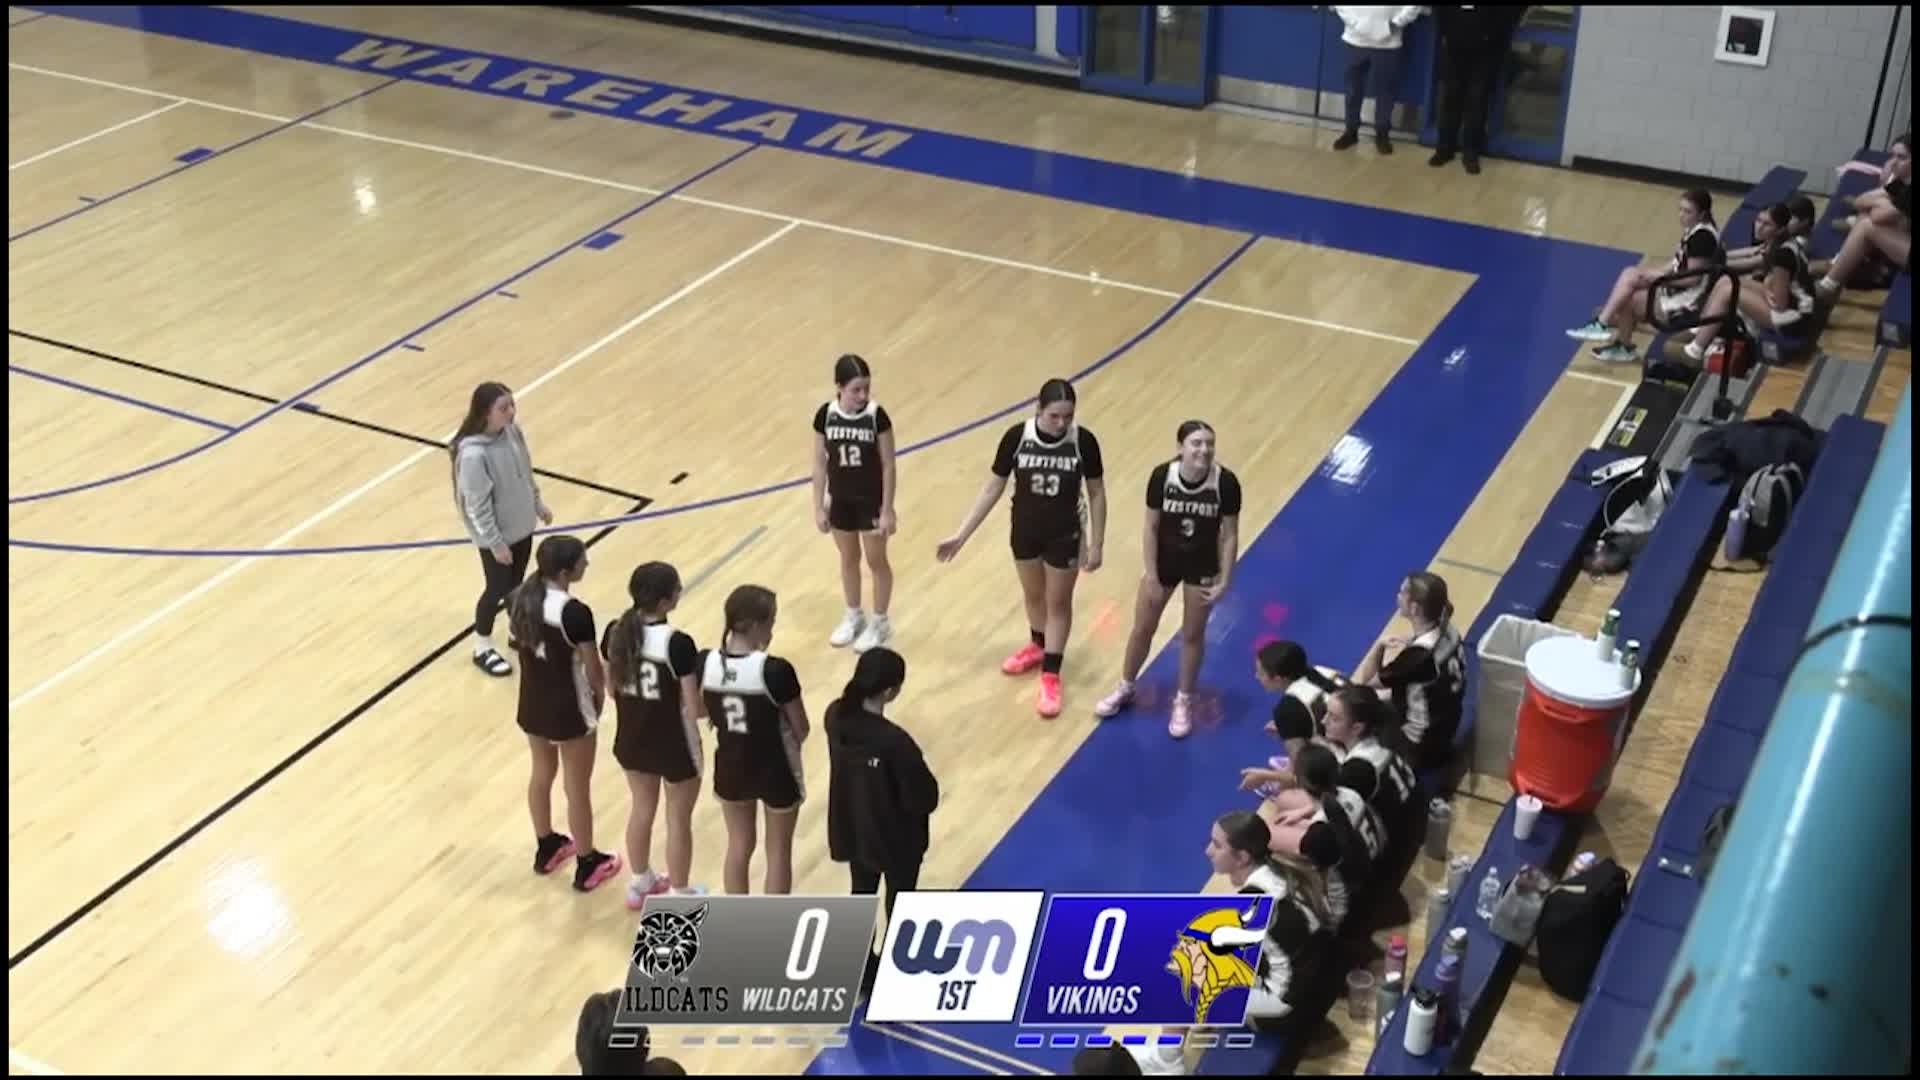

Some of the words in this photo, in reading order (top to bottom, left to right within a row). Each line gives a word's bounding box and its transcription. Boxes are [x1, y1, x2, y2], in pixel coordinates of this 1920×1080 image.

[334, 38, 913, 159] WAREHAM
[838, 444, 863, 467] 12
[1018, 453, 1079, 472] WESTPORT
[1031, 473, 1060, 496] 23
[1163, 498, 1219, 517] WESTPORT
[1182, 519, 1195, 537] 3
[722, 696, 749, 733] 2
